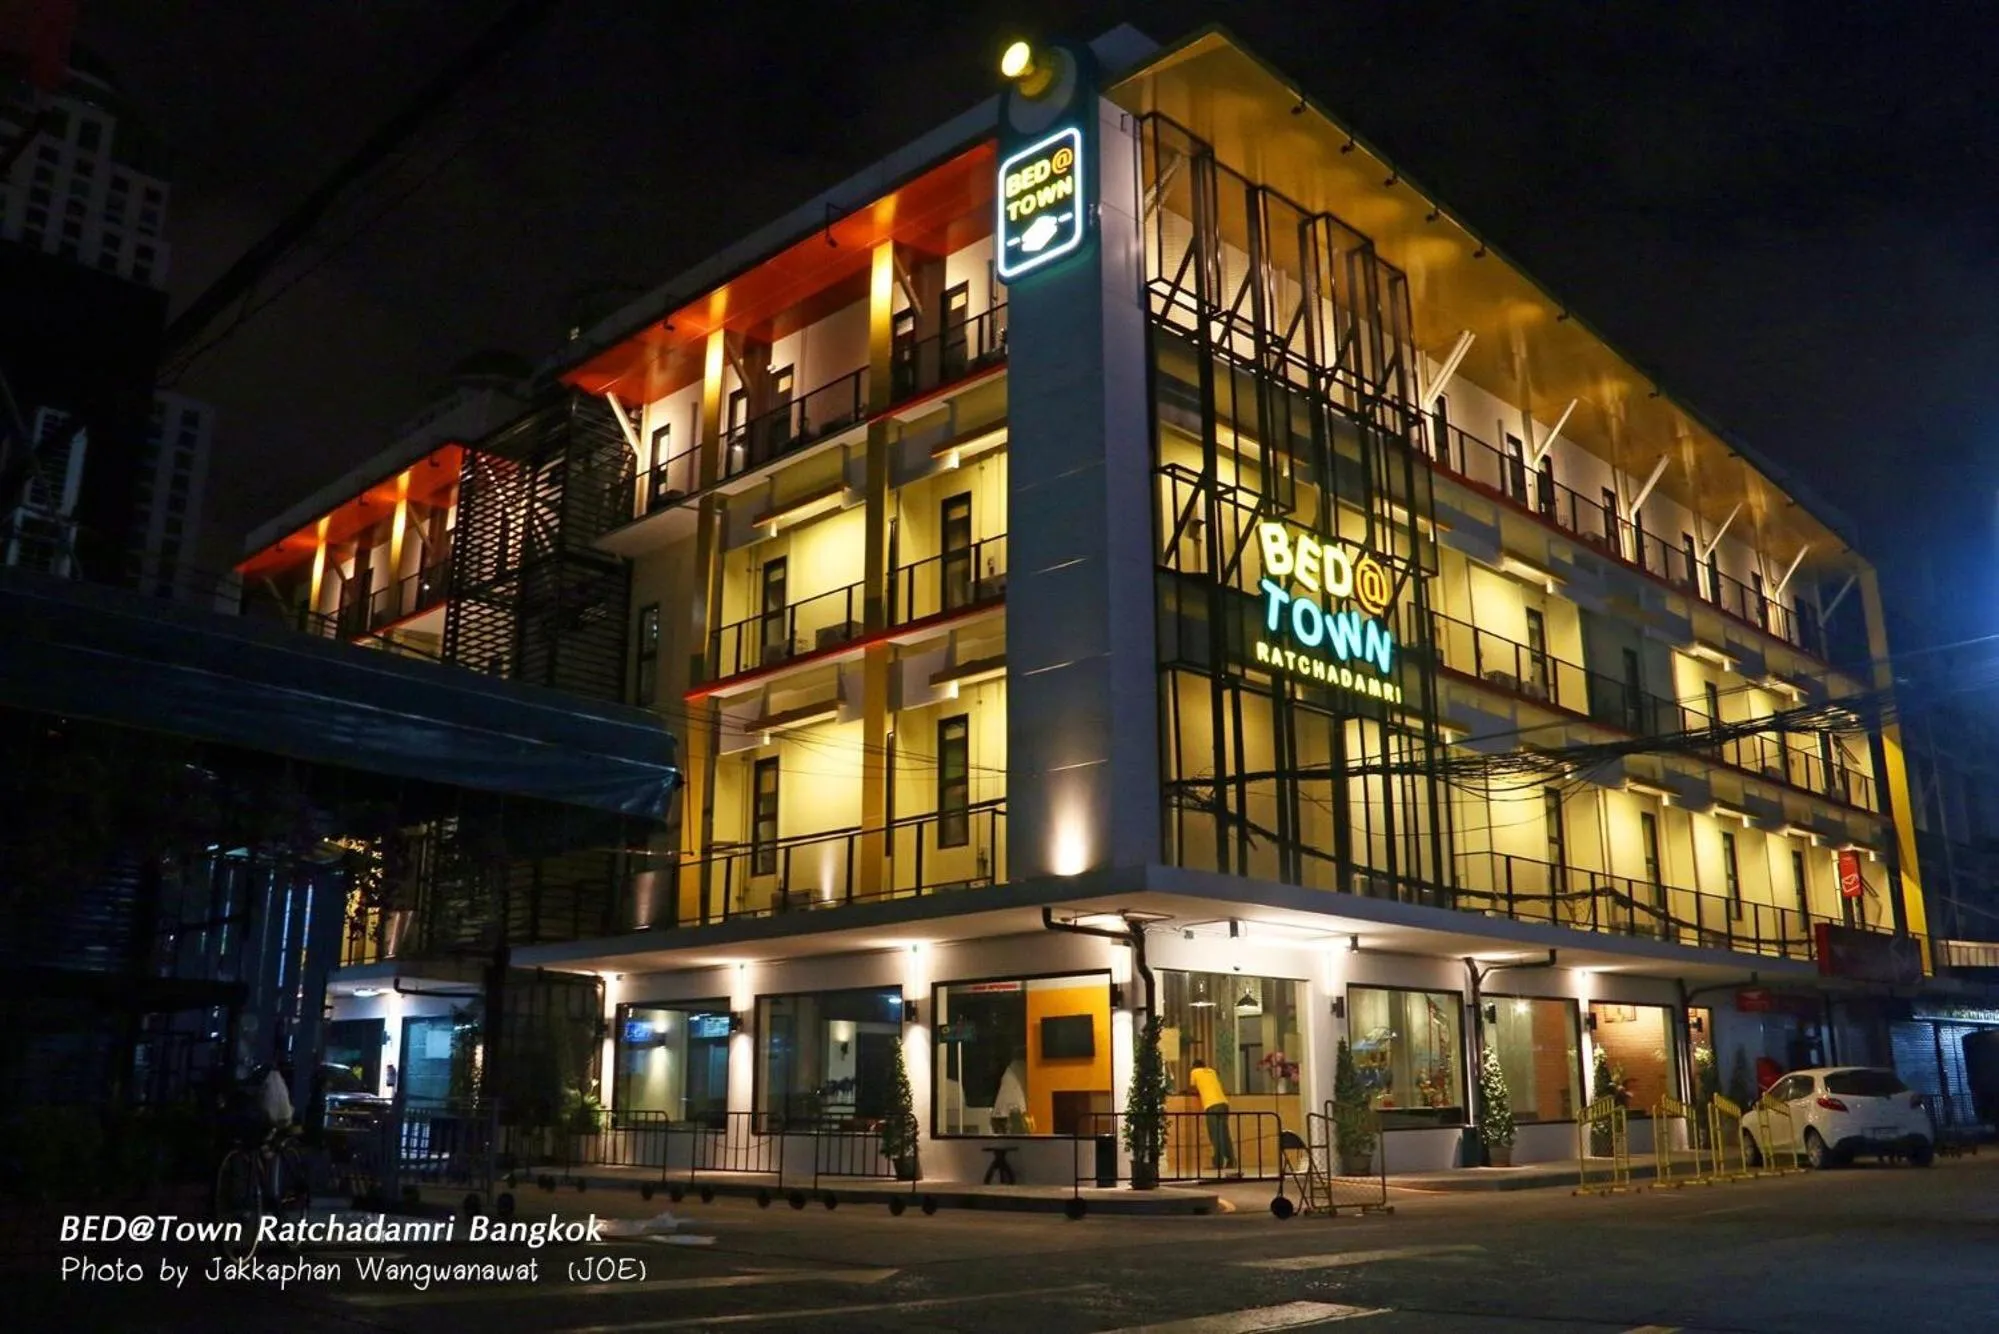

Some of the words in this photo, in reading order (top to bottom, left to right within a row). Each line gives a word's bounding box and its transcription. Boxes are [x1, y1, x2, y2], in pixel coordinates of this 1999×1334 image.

[1006, 148, 1073, 198] BED@
[1007, 176, 1073, 221] TOWN
[1259, 522, 1388, 615] BED@
[1261, 578, 1392, 674] TOWN
[1256, 641, 1402, 704] RATCHADAMRI
